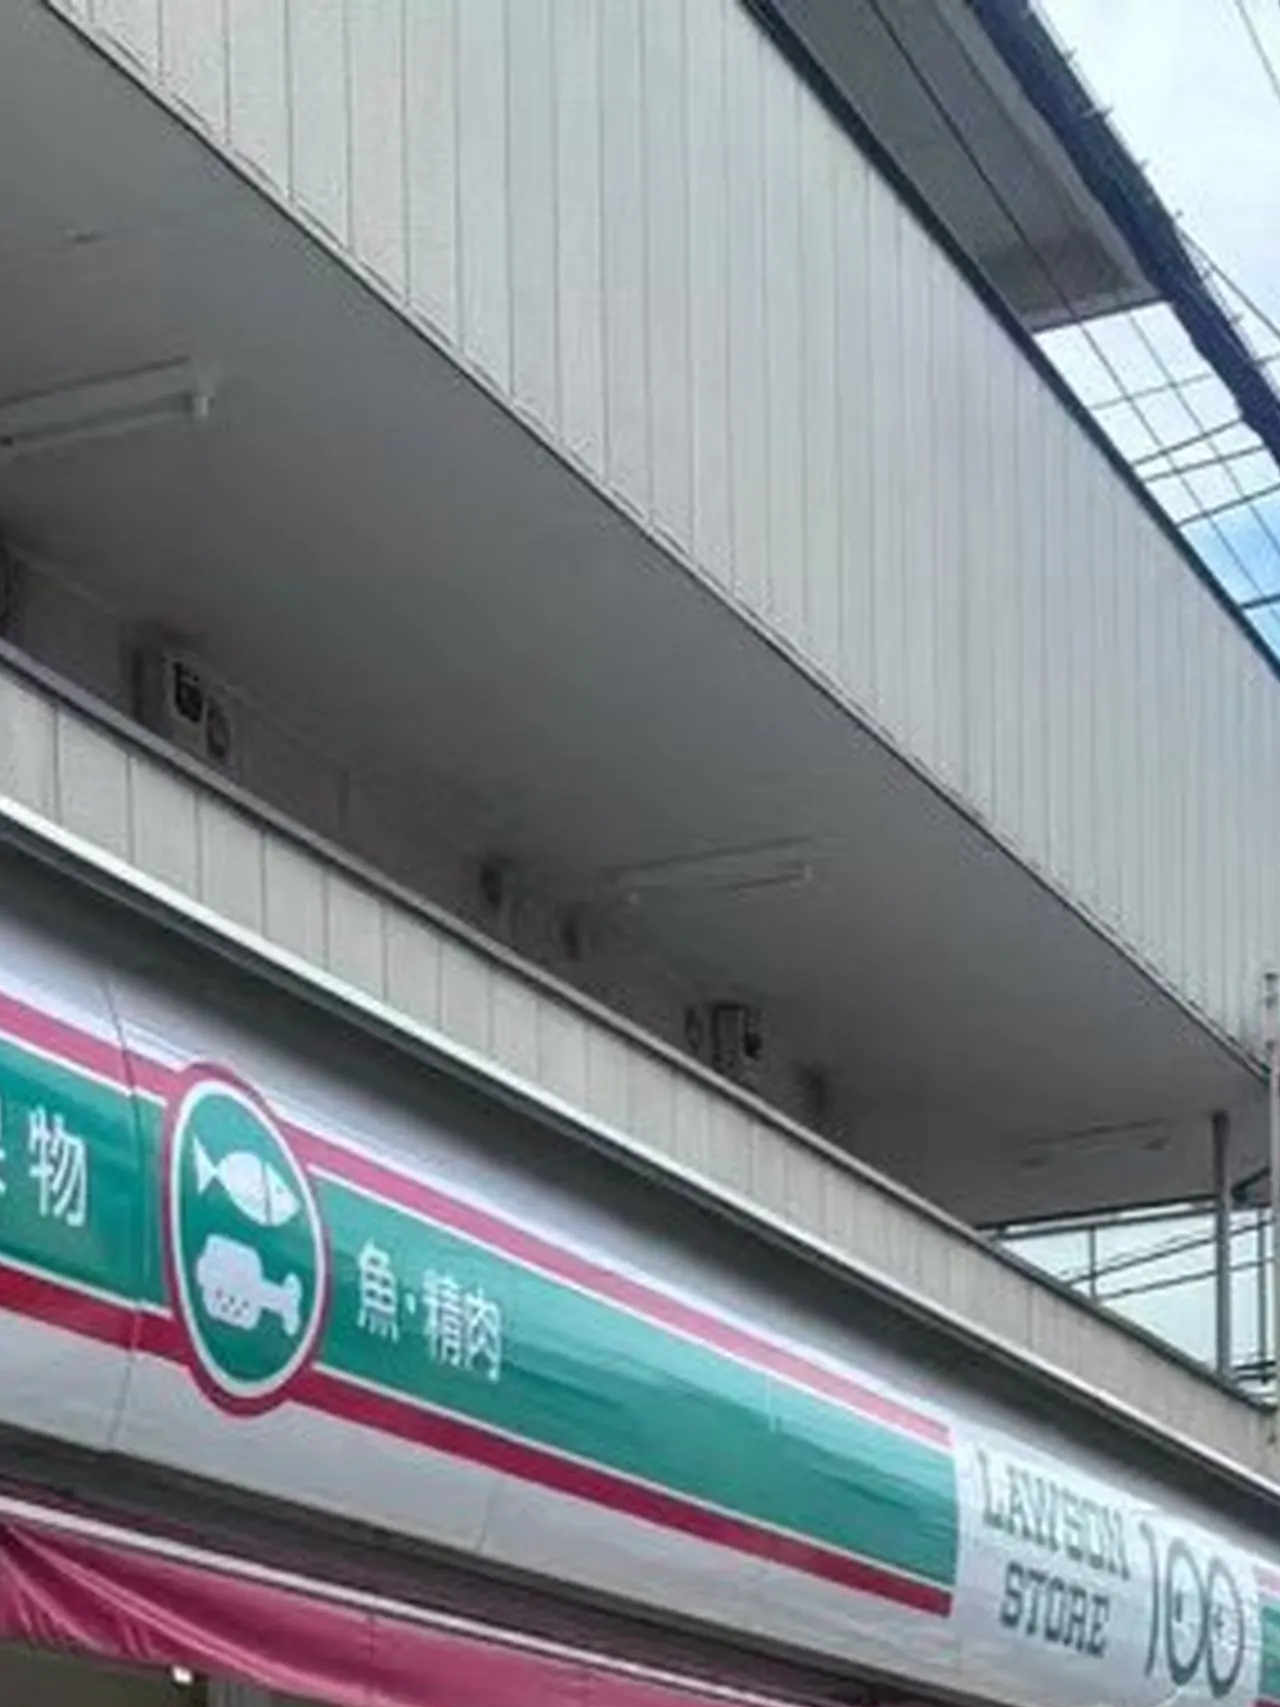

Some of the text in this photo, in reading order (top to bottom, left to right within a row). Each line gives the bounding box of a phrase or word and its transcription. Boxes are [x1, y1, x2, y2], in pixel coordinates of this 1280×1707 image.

[977, 1447, 1132, 1580] LAWSON
[999, 1562, 1110, 1656] STORE
[1140, 1521, 1245, 1697] 100
